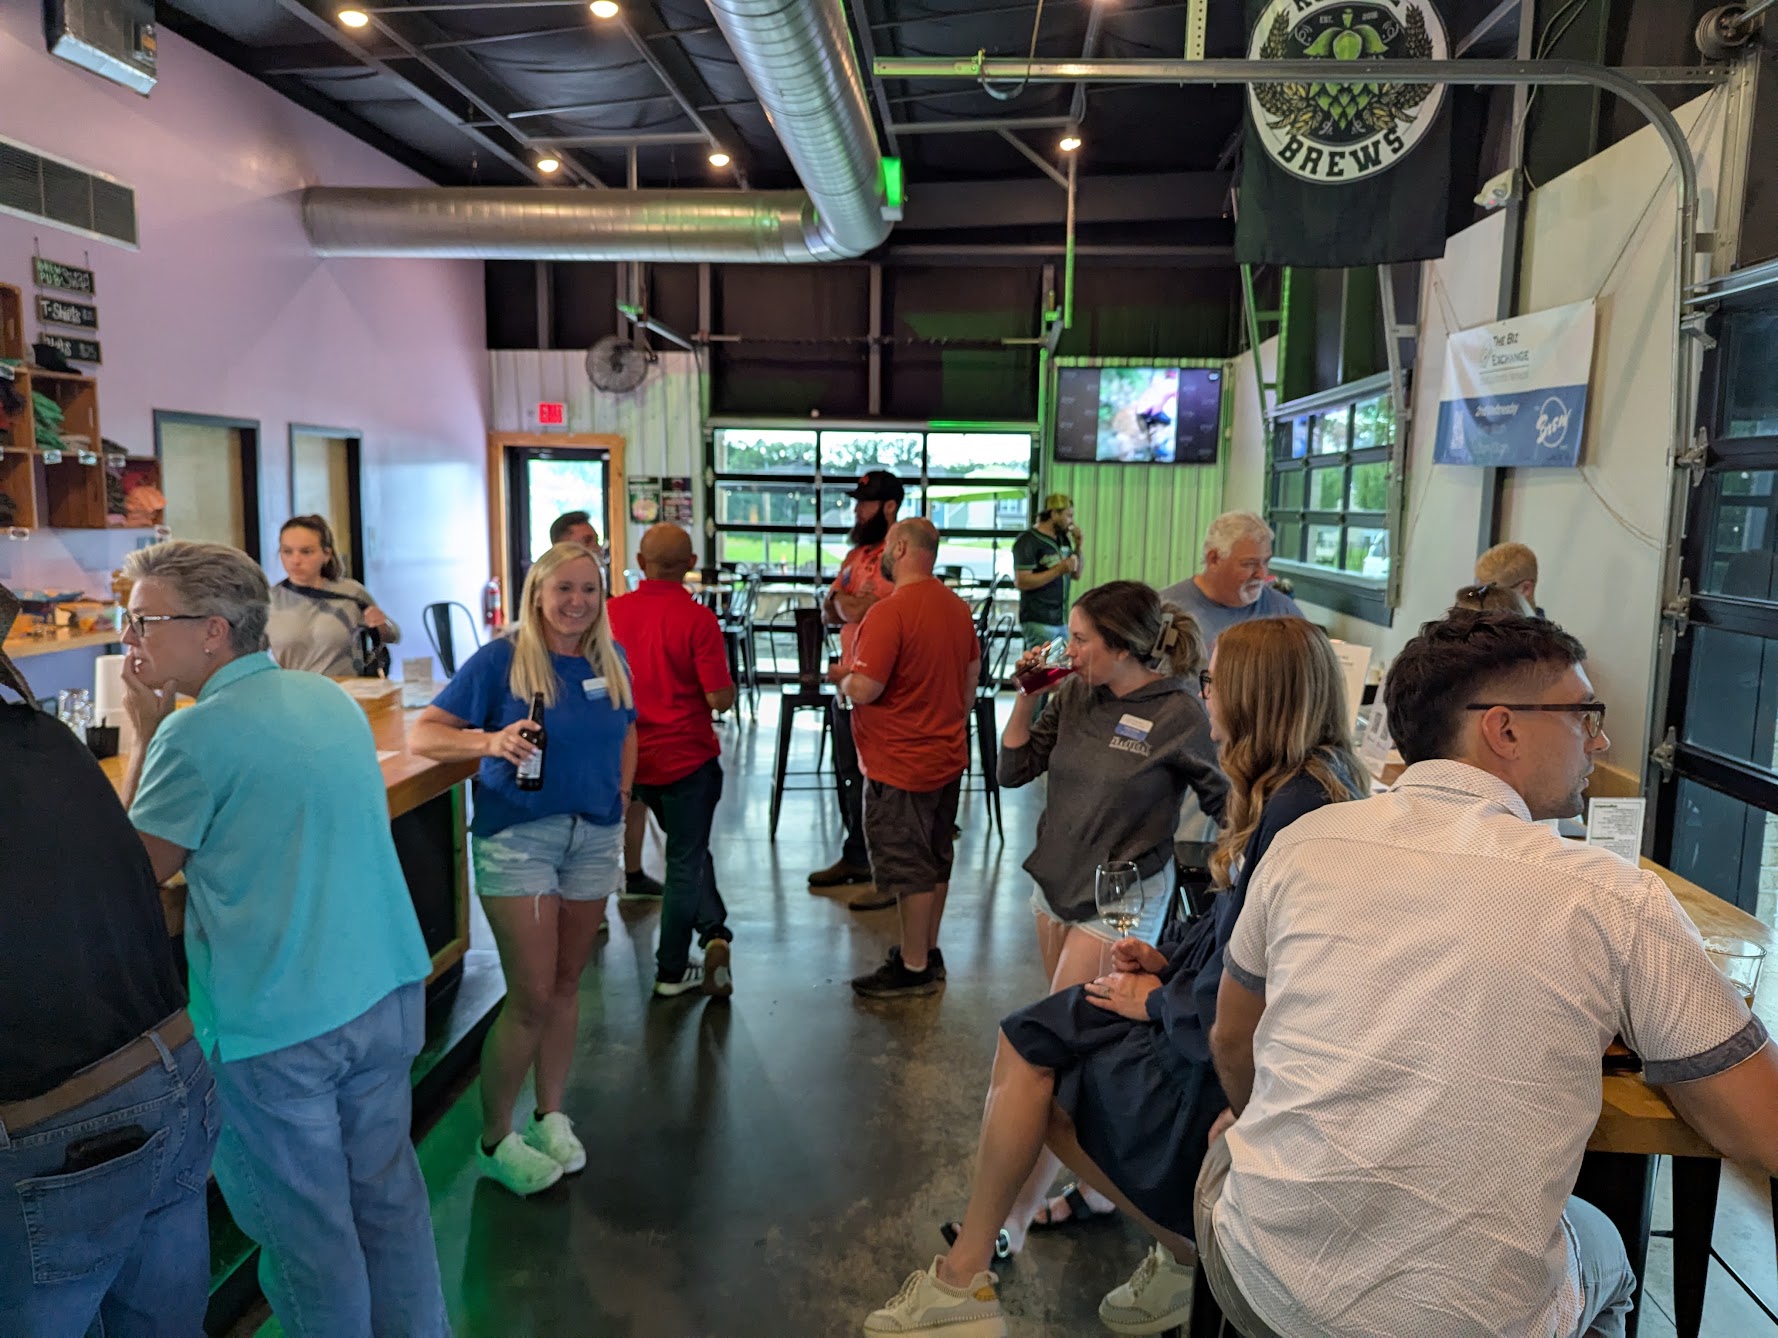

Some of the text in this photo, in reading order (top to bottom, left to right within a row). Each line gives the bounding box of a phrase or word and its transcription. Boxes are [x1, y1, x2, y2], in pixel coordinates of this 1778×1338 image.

[1277, 126, 1404, 177] BREWS
[1492, 331, 1519, 347] THE BIZ
